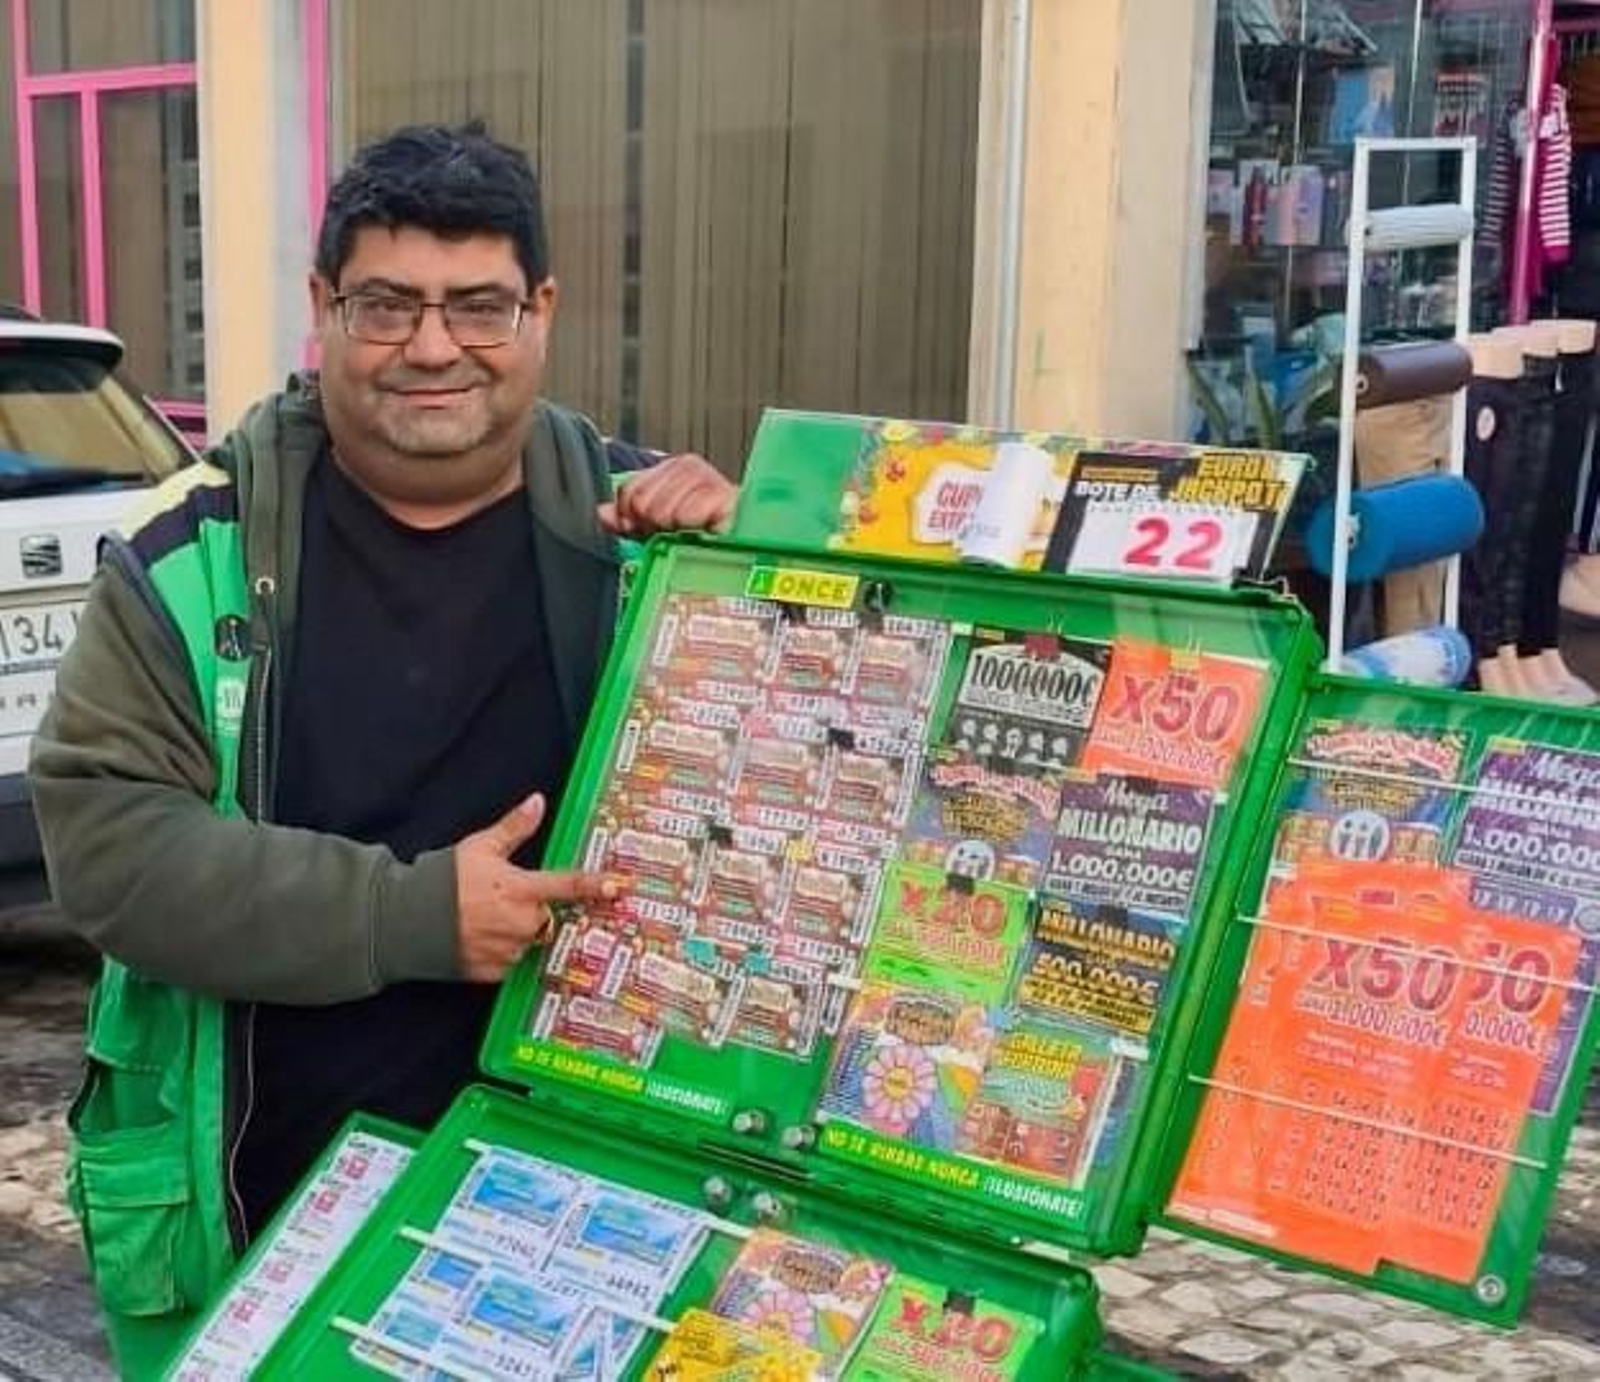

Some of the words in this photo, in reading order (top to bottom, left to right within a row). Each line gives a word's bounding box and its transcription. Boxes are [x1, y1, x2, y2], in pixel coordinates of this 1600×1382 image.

[1075, 480, 1126, 503] BOTE
[777, 576, 848, 598] ONCE
[1058, 808, 1203, 854] MILLONARIO
[1051, 851, 1194, 891] 1.000.000€
